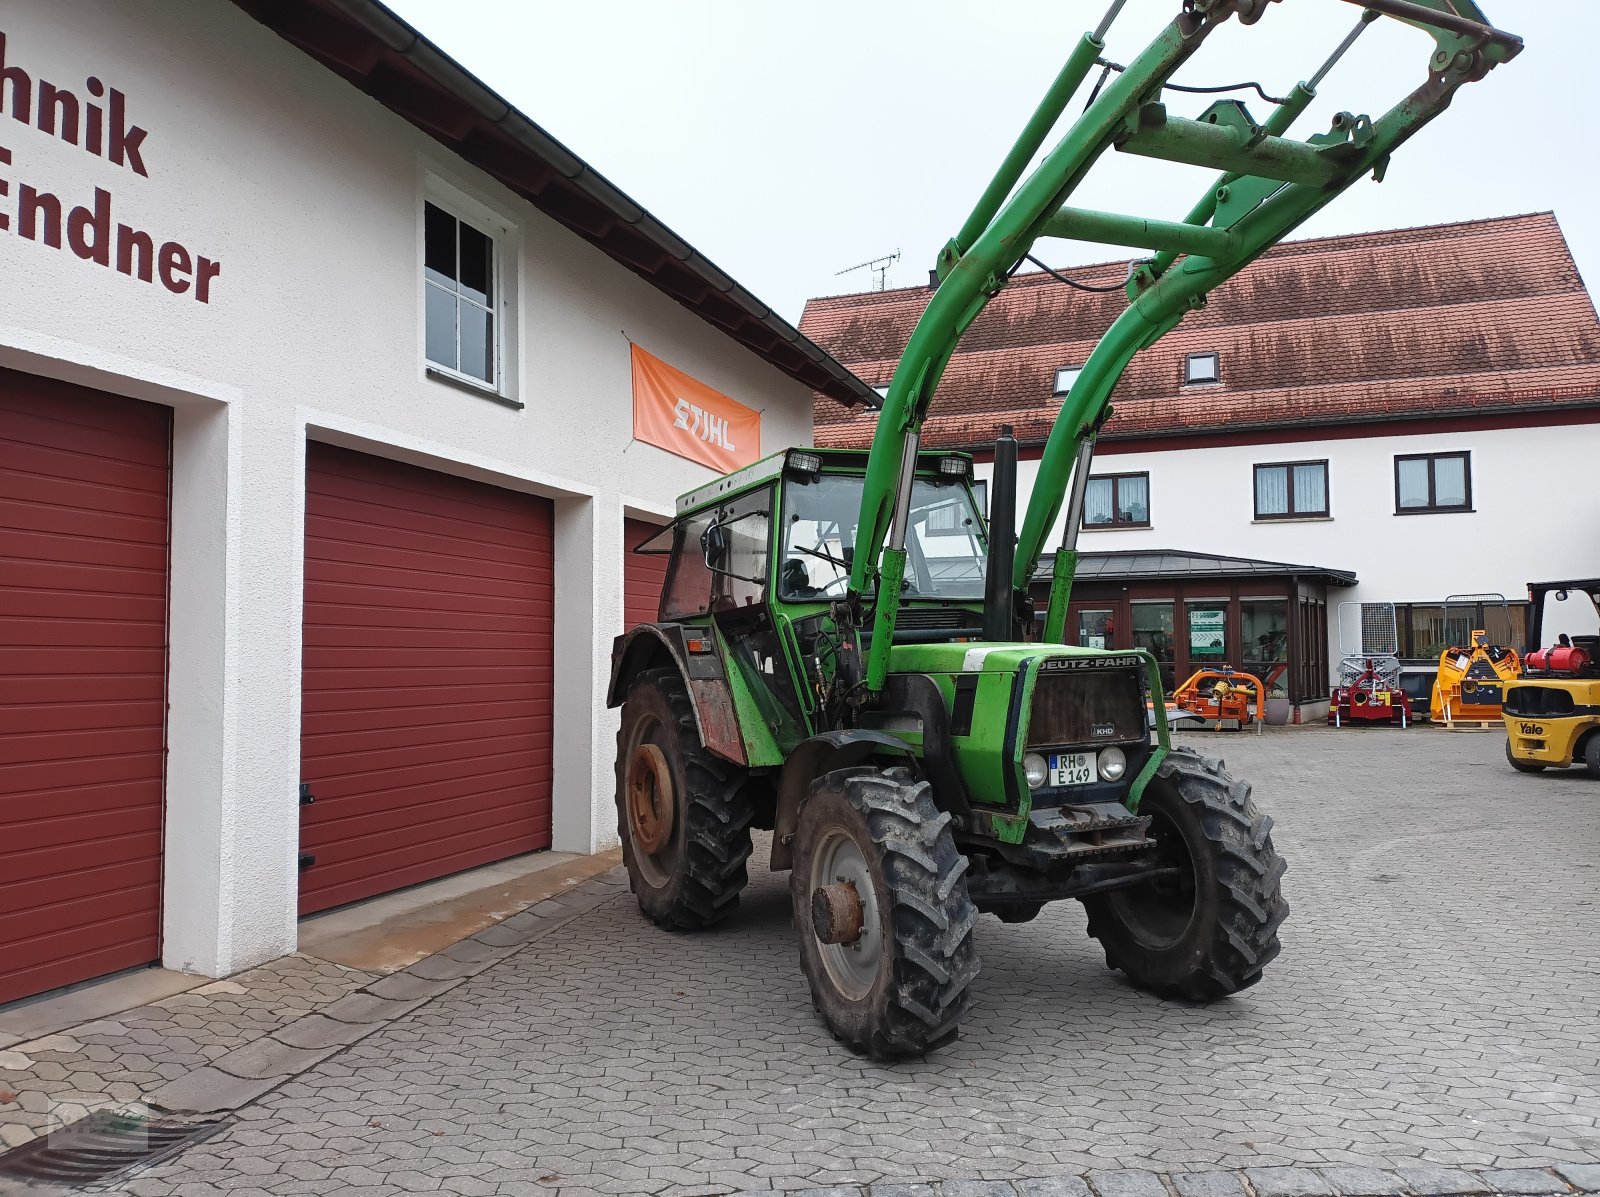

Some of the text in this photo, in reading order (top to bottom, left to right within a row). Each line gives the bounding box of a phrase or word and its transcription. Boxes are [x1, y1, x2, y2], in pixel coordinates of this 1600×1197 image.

[0, 31, 148, 178] hnik
[673, 397, 736, 452] STIHL
[1520, 723, 1543, 734] Yale
[1060, 755, 1076, 769] RH
[1058, 768, 1090, 784] E 149
